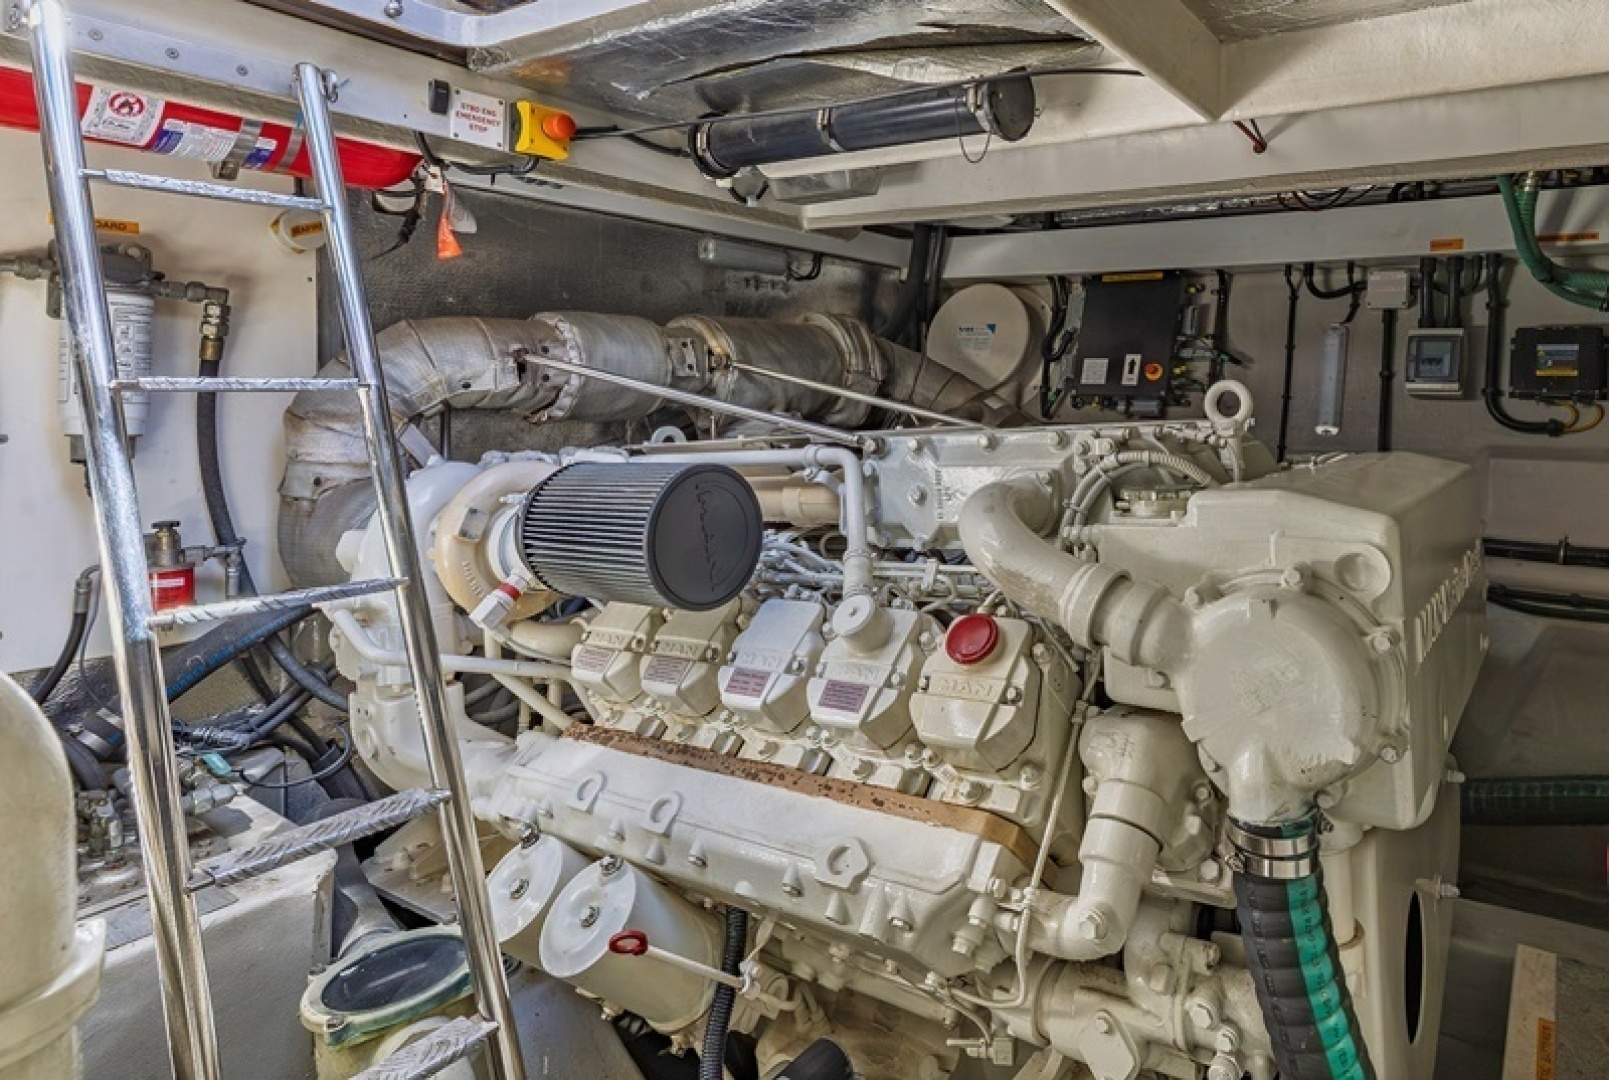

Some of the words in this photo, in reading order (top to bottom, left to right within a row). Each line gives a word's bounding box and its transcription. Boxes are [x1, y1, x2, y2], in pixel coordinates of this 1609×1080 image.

[456, 110, 500, 127] EMERGENCY
[469, 122, 488, 132] STOP
[592, 630, 628, 649] MAN
[660, 640, 700, 660] MAN
[939, 678, 994, 697] MAN
